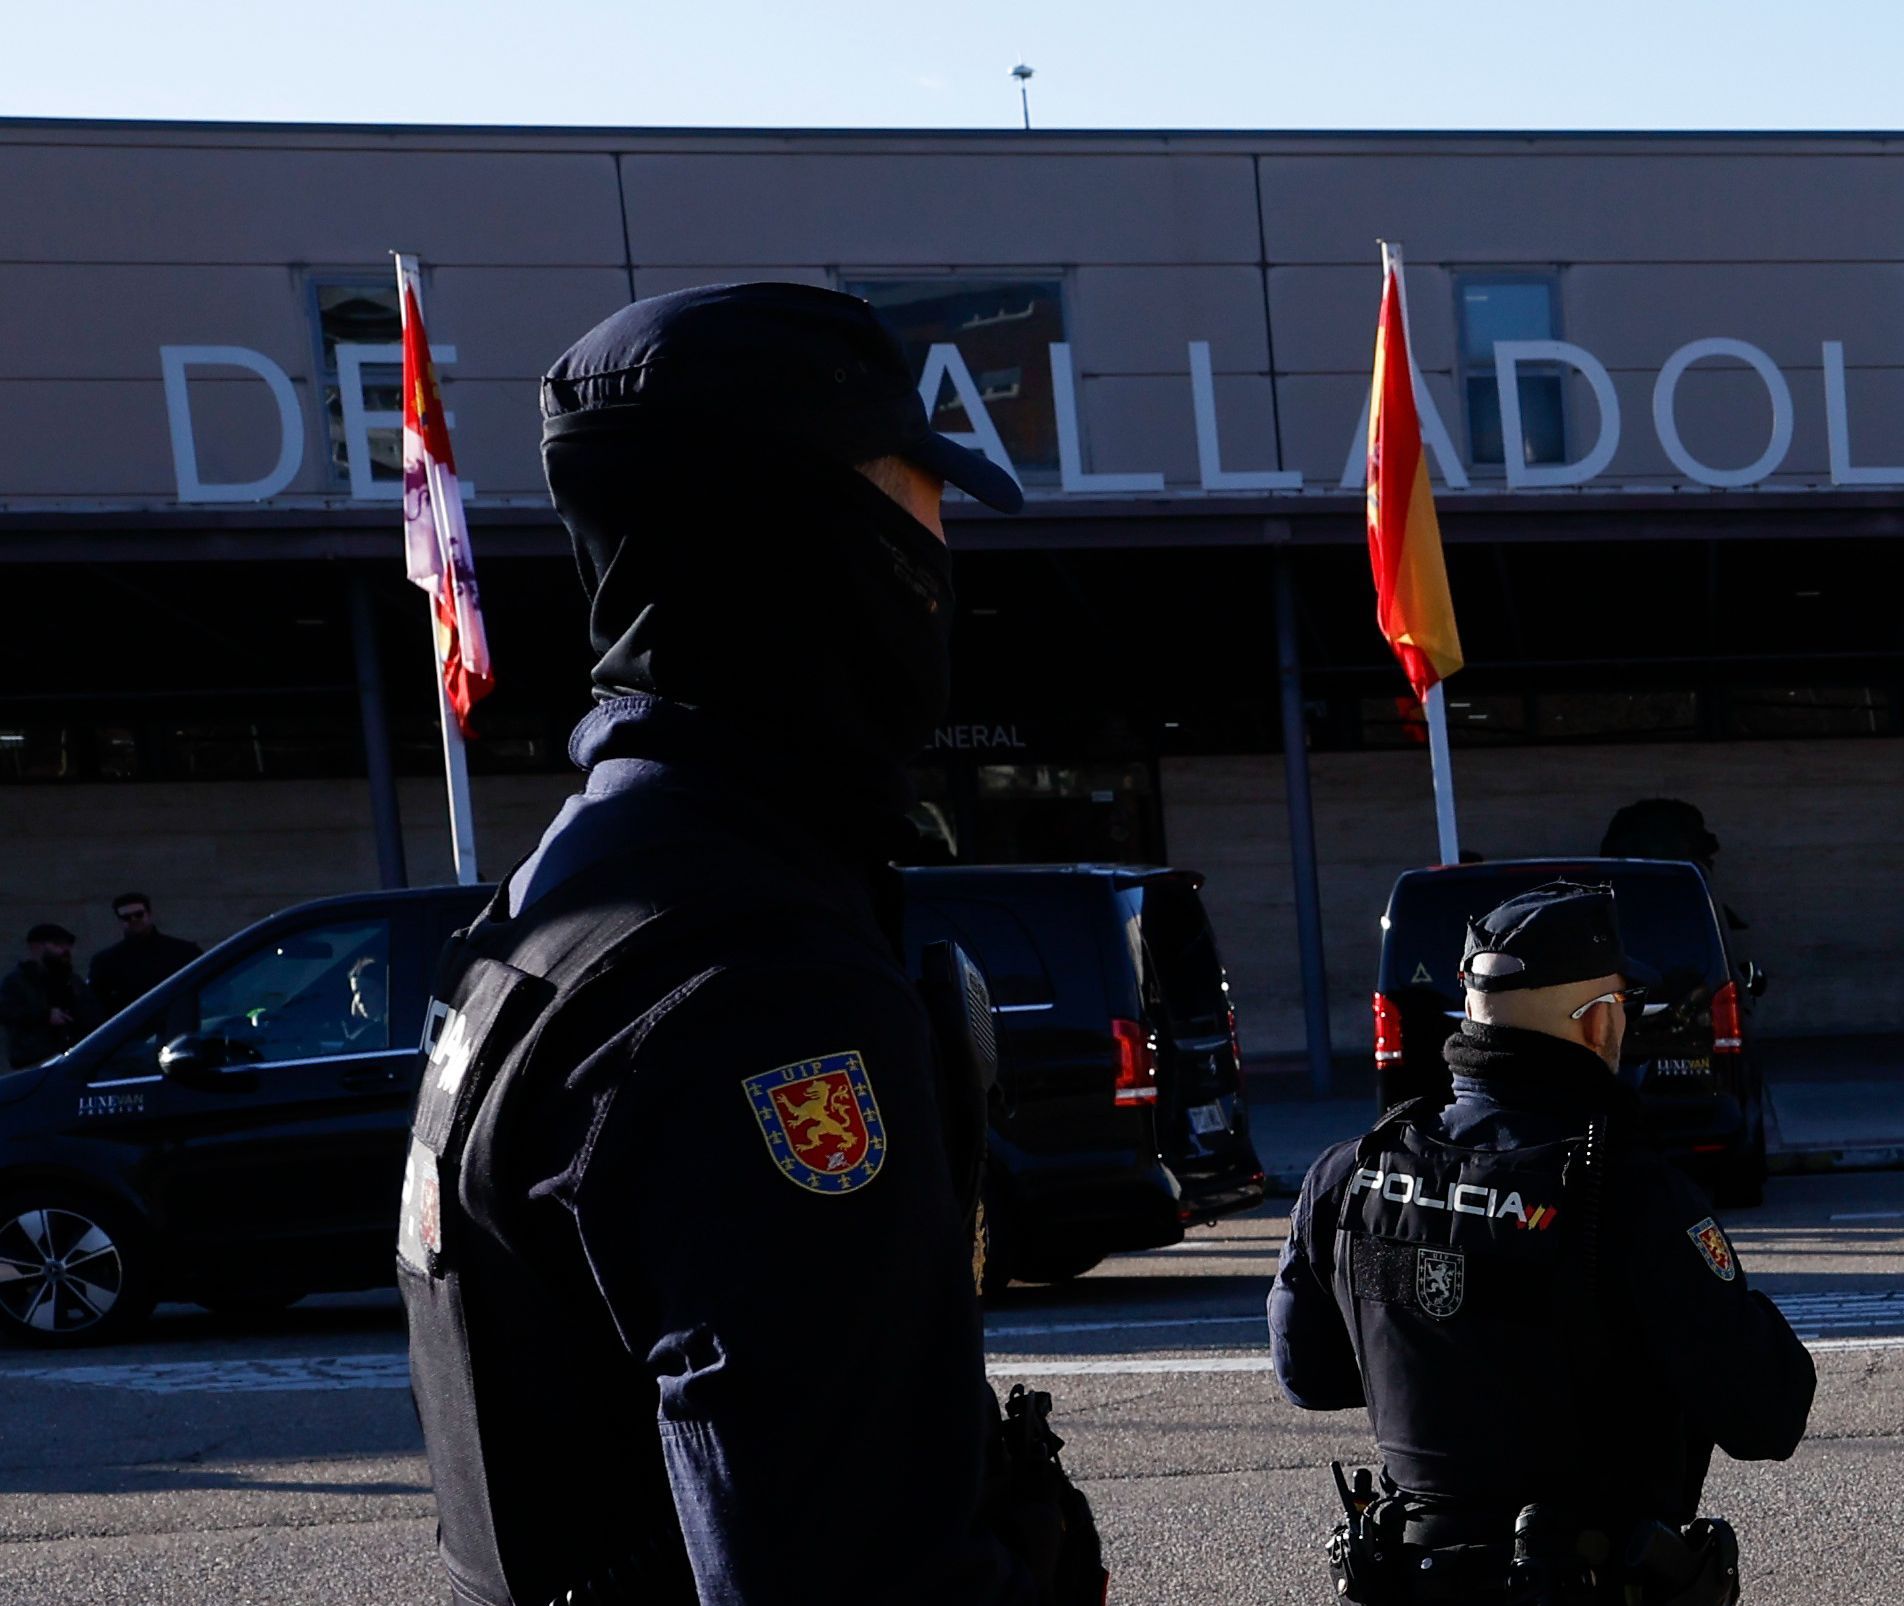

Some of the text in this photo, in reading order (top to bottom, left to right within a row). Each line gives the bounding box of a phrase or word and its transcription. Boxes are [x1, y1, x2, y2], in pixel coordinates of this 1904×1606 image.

[160, 345, 474, 502] DE
[924, 724, 1027, 748] NERAL
[780, 1061, 823, 1081] UIP
[1350, 1166, 1528, 1223] POLICIA
